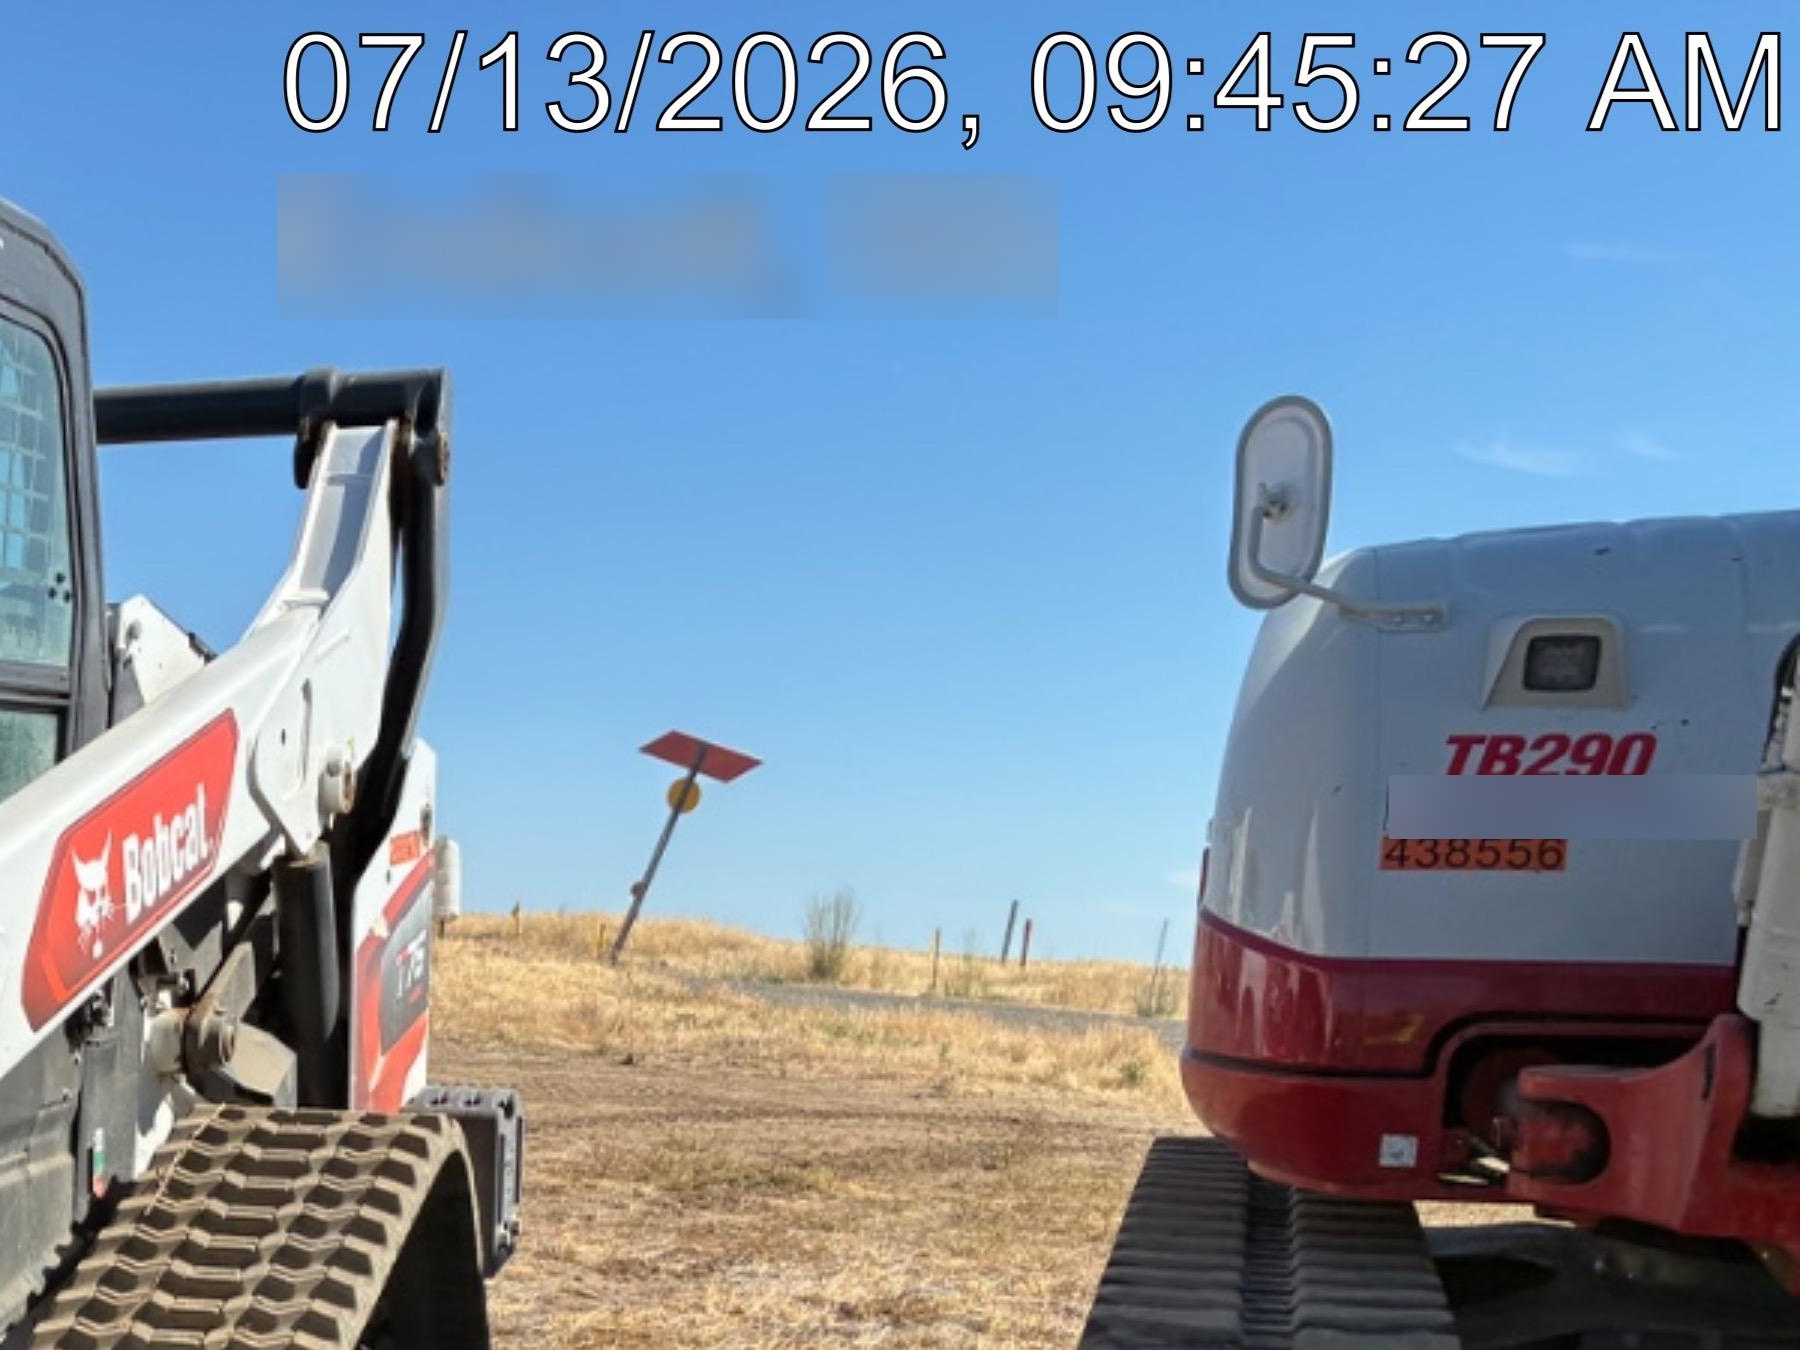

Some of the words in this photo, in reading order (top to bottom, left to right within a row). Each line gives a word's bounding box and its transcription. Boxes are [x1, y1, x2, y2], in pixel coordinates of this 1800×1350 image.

[1446, 732, 1657, 775] TB290
[122, 783, 209, 924] Bobcat
[1384, 839, 1564, 869] 438556
